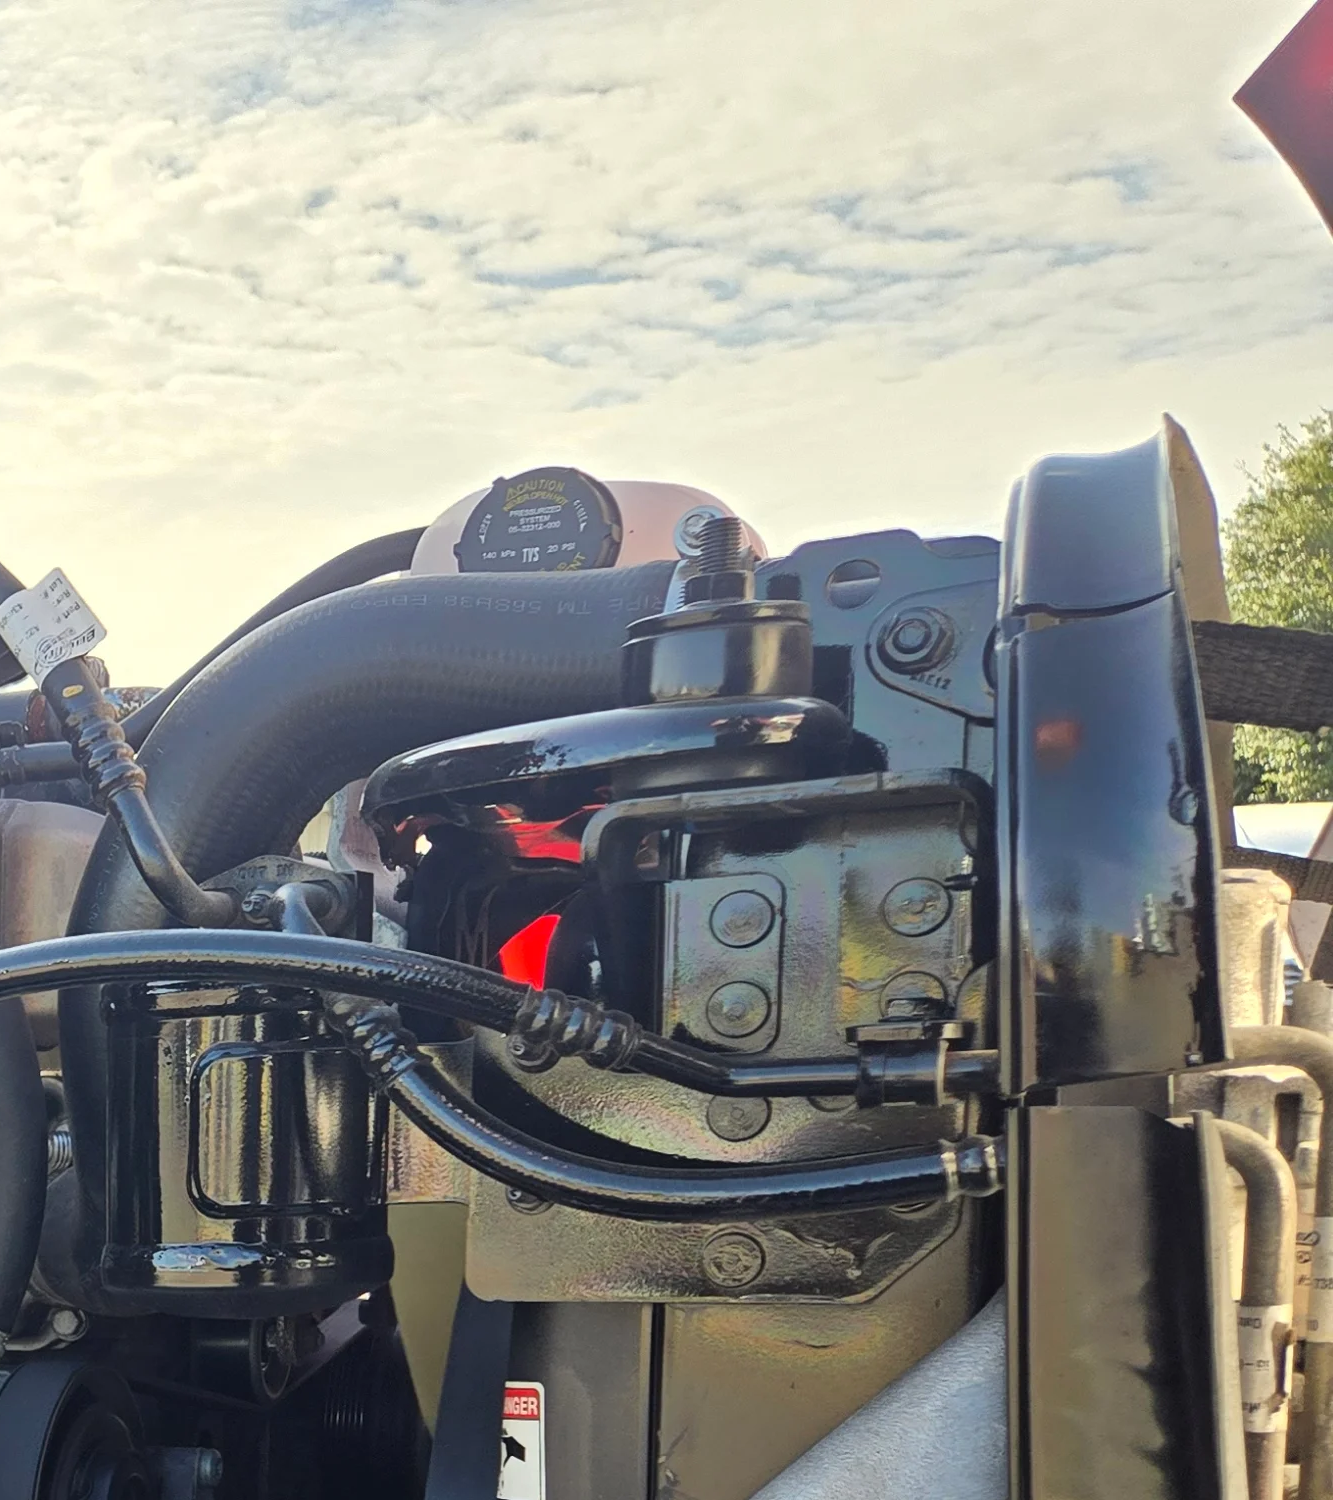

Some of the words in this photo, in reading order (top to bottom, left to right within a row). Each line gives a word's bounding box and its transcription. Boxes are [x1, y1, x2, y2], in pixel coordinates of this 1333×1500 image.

[517, 479, 565, 493] CAUTION
[509, 505, 562, 518] PRESSURIZED
[519, 514, 551, 525] SYSTEM
[522, 546, 540, 563] TVS
